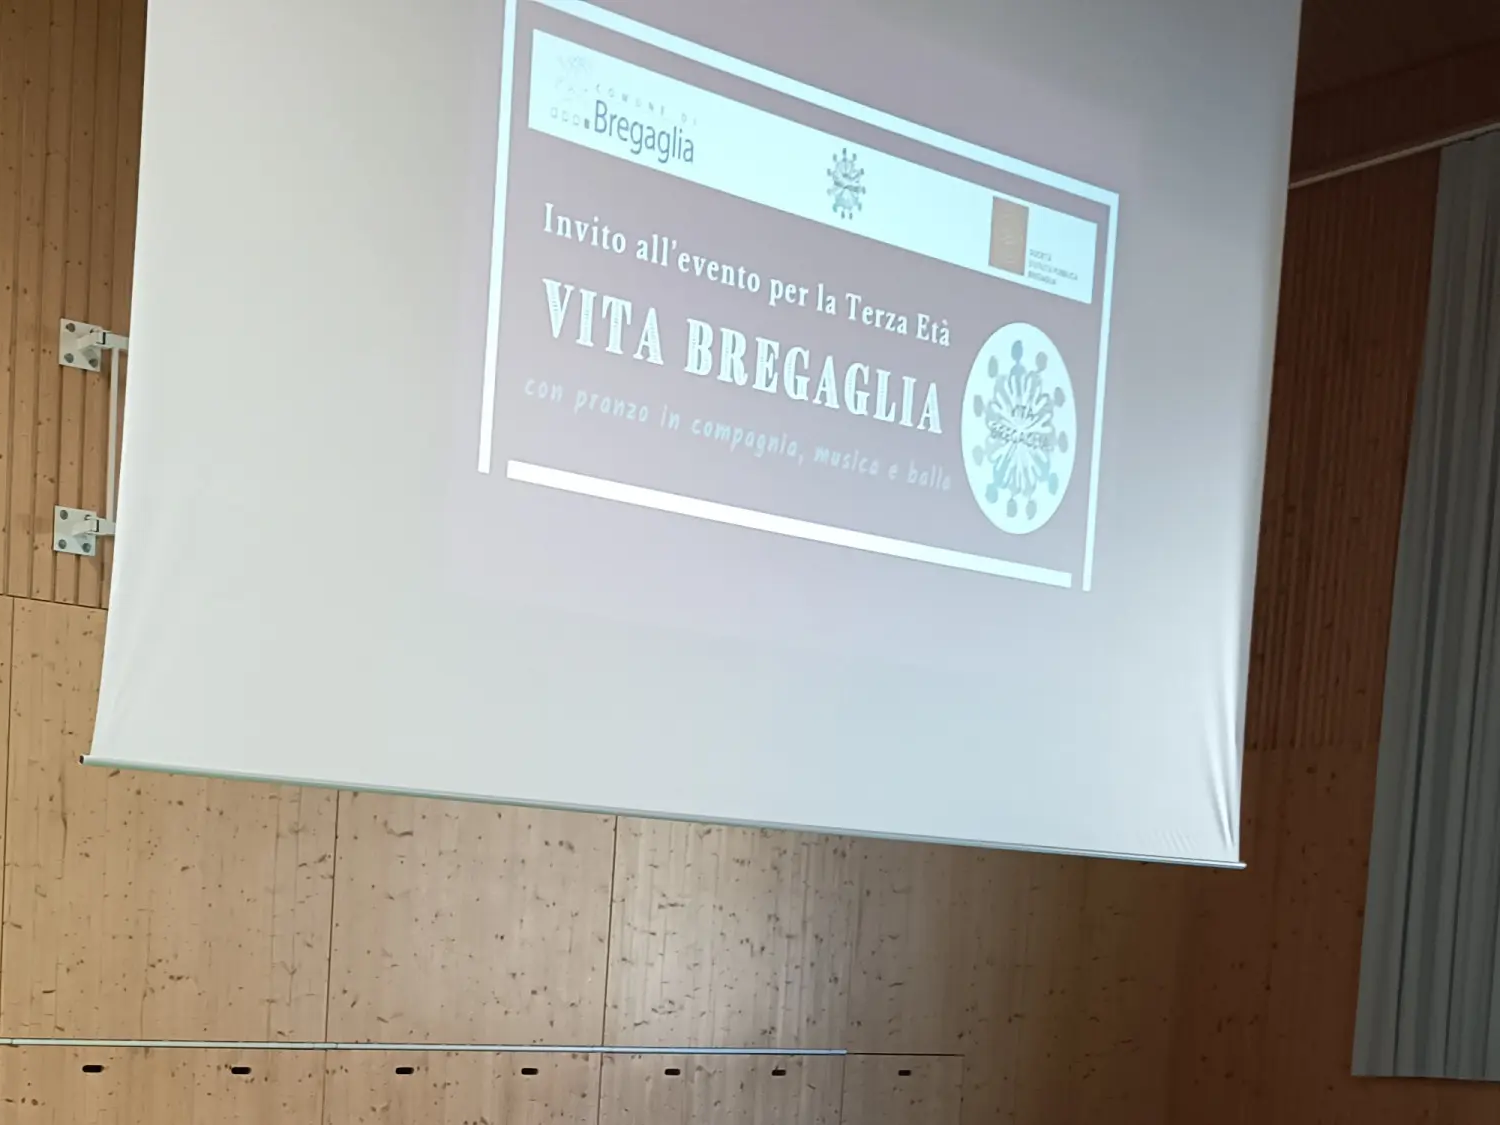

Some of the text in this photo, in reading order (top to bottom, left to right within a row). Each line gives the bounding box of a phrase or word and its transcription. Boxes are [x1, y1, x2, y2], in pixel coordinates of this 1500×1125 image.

[594, 99, 695, 163] Bregaglia
[543, 202, 951, 347] Invito all'evento per la Terza Età
[541, 277, 943, 435] VITA BREGAGLIA
[524, 378, 952, 492] con pranzo in compagnia, musica e ballo
